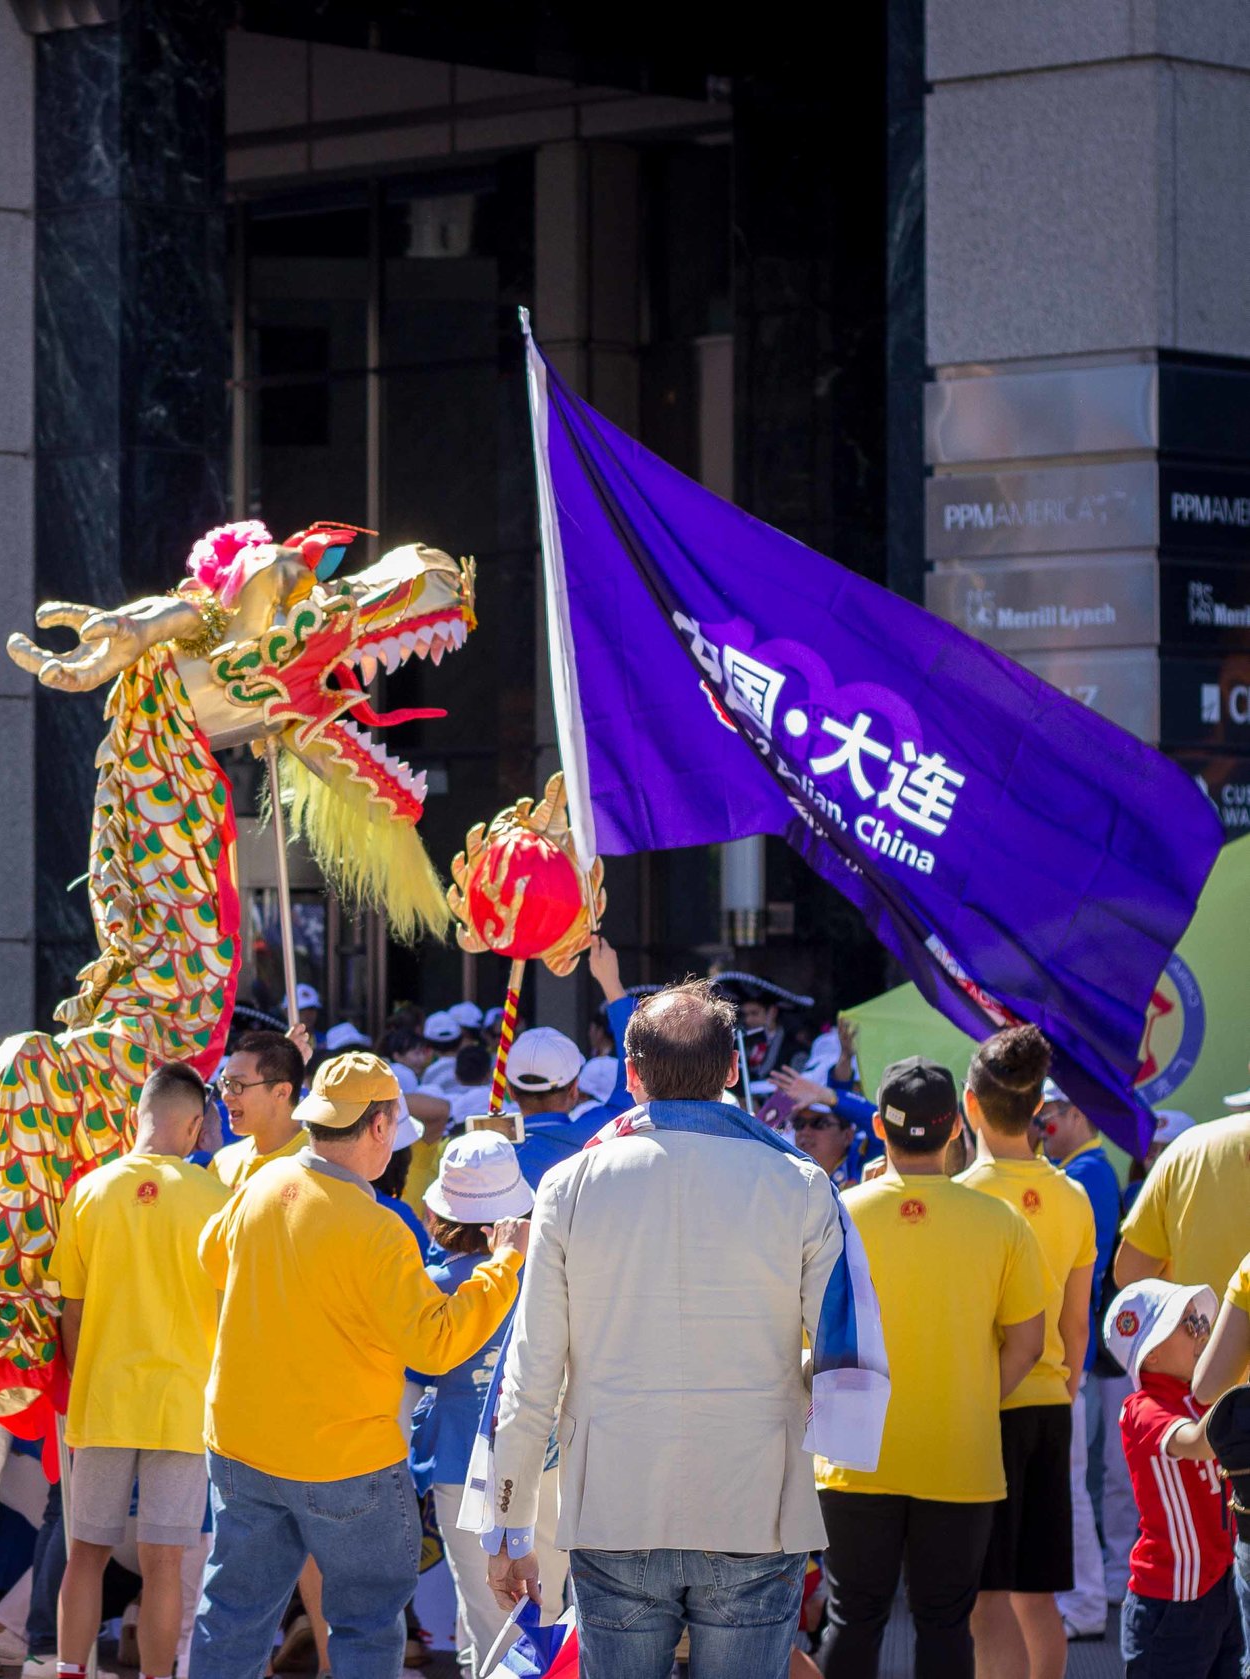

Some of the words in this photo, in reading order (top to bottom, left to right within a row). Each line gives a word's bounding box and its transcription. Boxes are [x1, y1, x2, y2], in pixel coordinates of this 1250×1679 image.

[997, 605, 1057, 630] Merrill
[1059, 602, 1117, 630] Lynch
[854, 814, 936, 875] China
